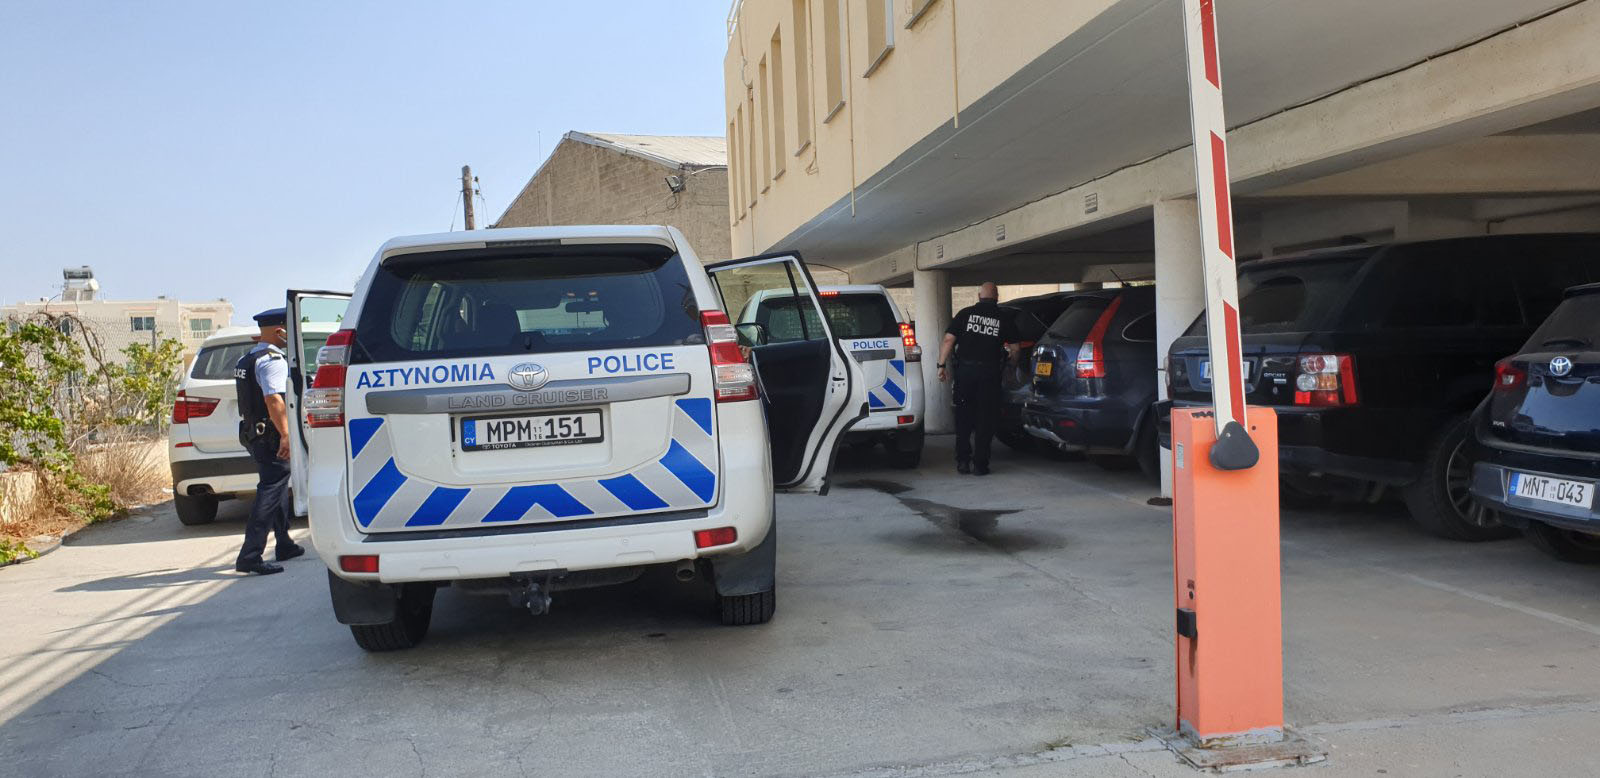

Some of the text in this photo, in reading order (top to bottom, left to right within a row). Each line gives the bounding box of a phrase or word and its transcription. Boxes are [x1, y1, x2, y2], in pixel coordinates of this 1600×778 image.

[966, 323, 999, 336] POLICE
[853, 340, 889, 349] POLICE
[587, 352, 675, 374] POLICE
[356, 363, 495, 389] ΑΣΤΥΝΟΜΙΑ
[448, 387, 608, 409] LAND CRUISER
[487, 416, 586, 443] MPM 151
[1521, 476, 1550, 498] MNT
[1556, 482, 1585, 503] 043
